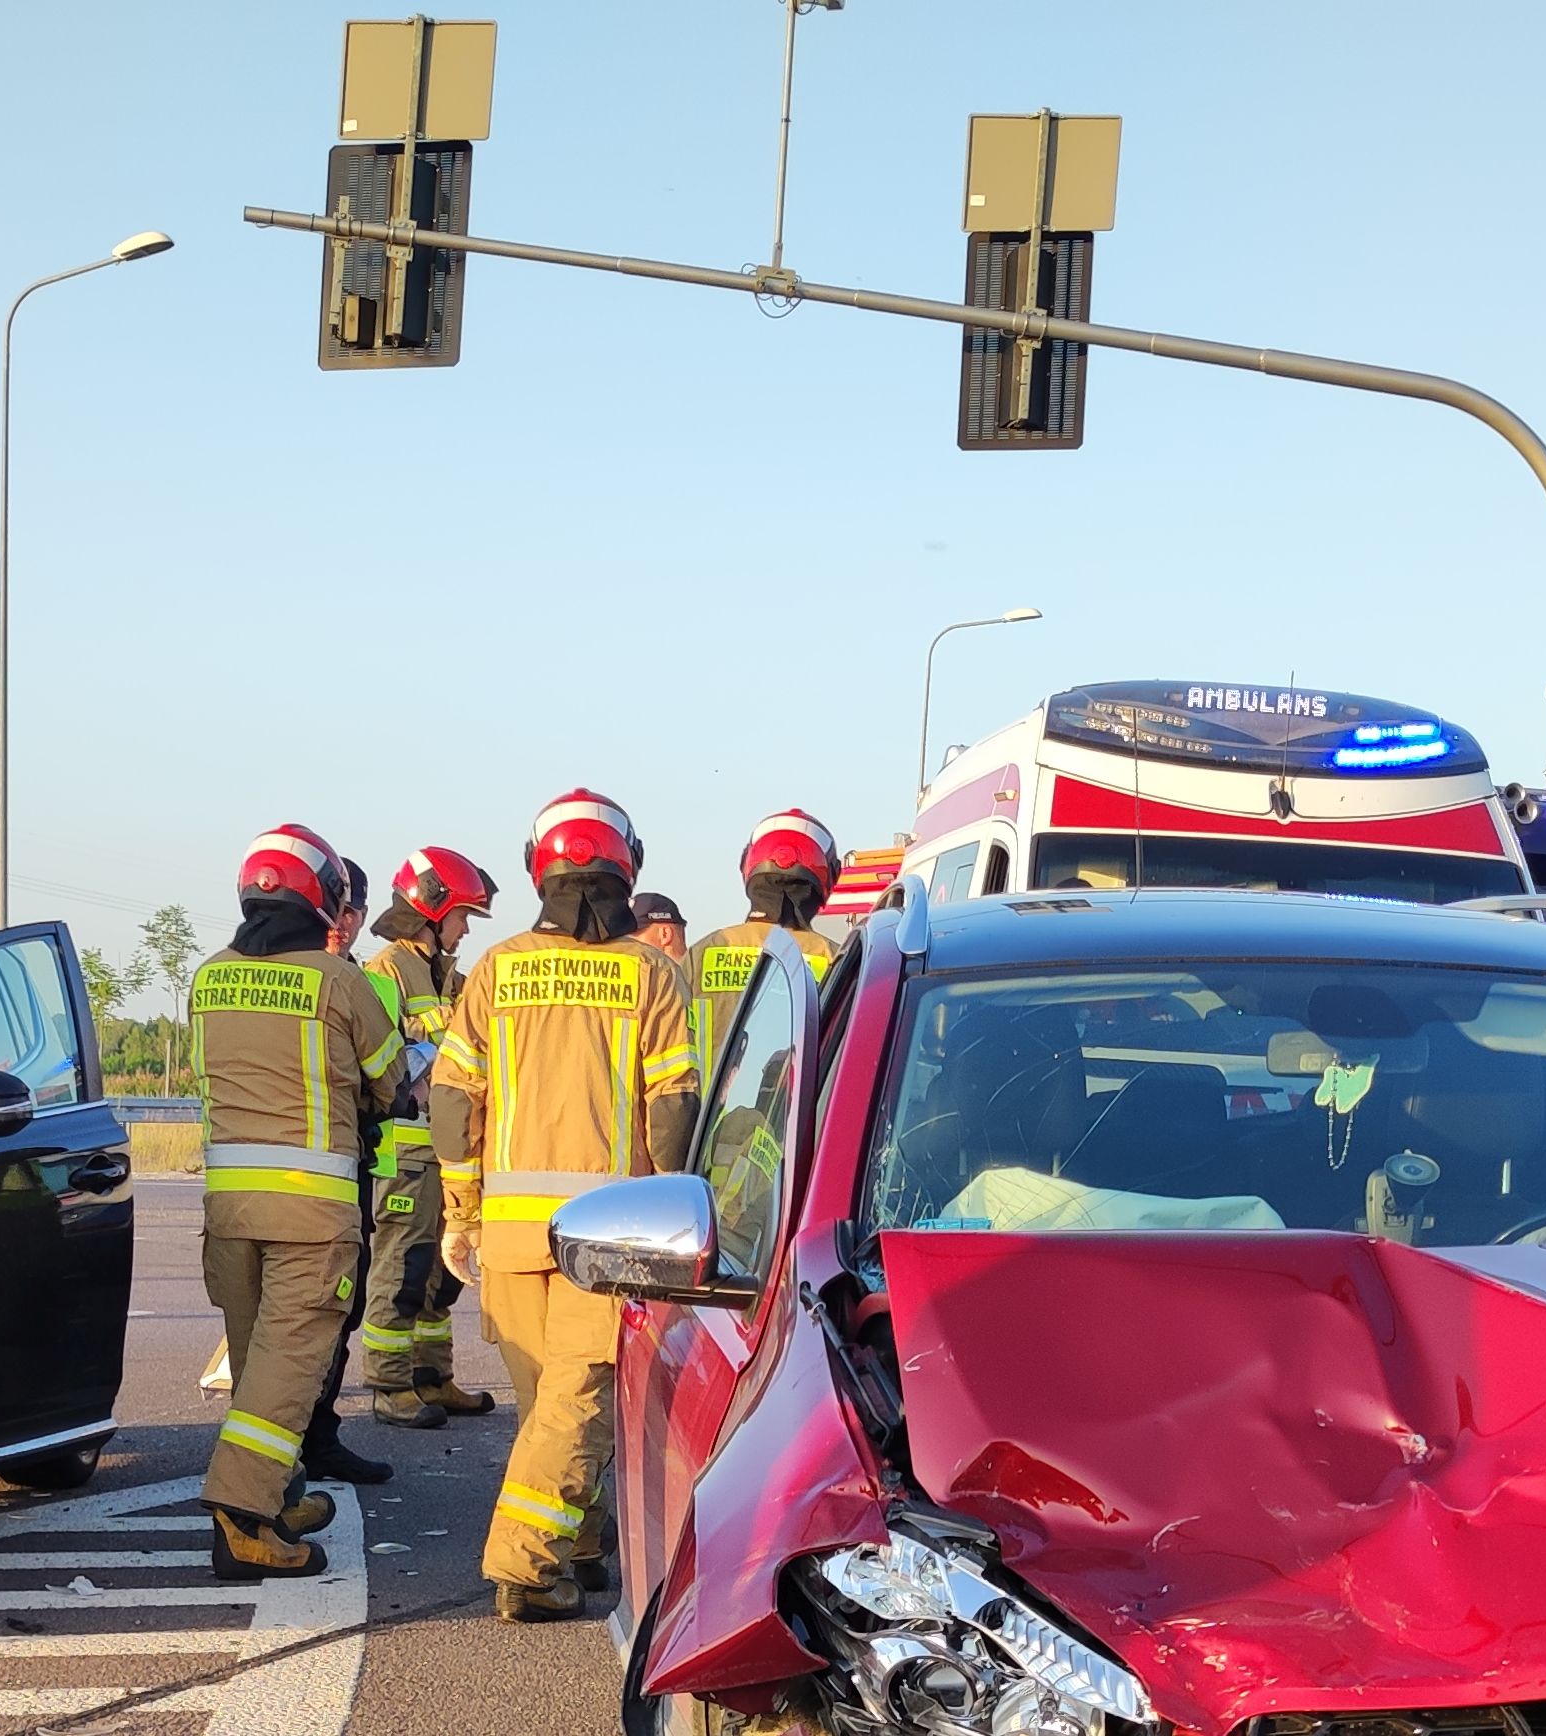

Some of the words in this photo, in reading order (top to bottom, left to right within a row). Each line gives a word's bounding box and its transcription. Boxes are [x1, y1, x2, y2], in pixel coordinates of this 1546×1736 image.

[1187, 686, 1328, 717] AMBULANS
[206, 965, 304, 989] PAŃSTWOWA
[510, 955, 621, 979] PAŃSTWOWA
[390, 1198, 410, 1210] PSP
